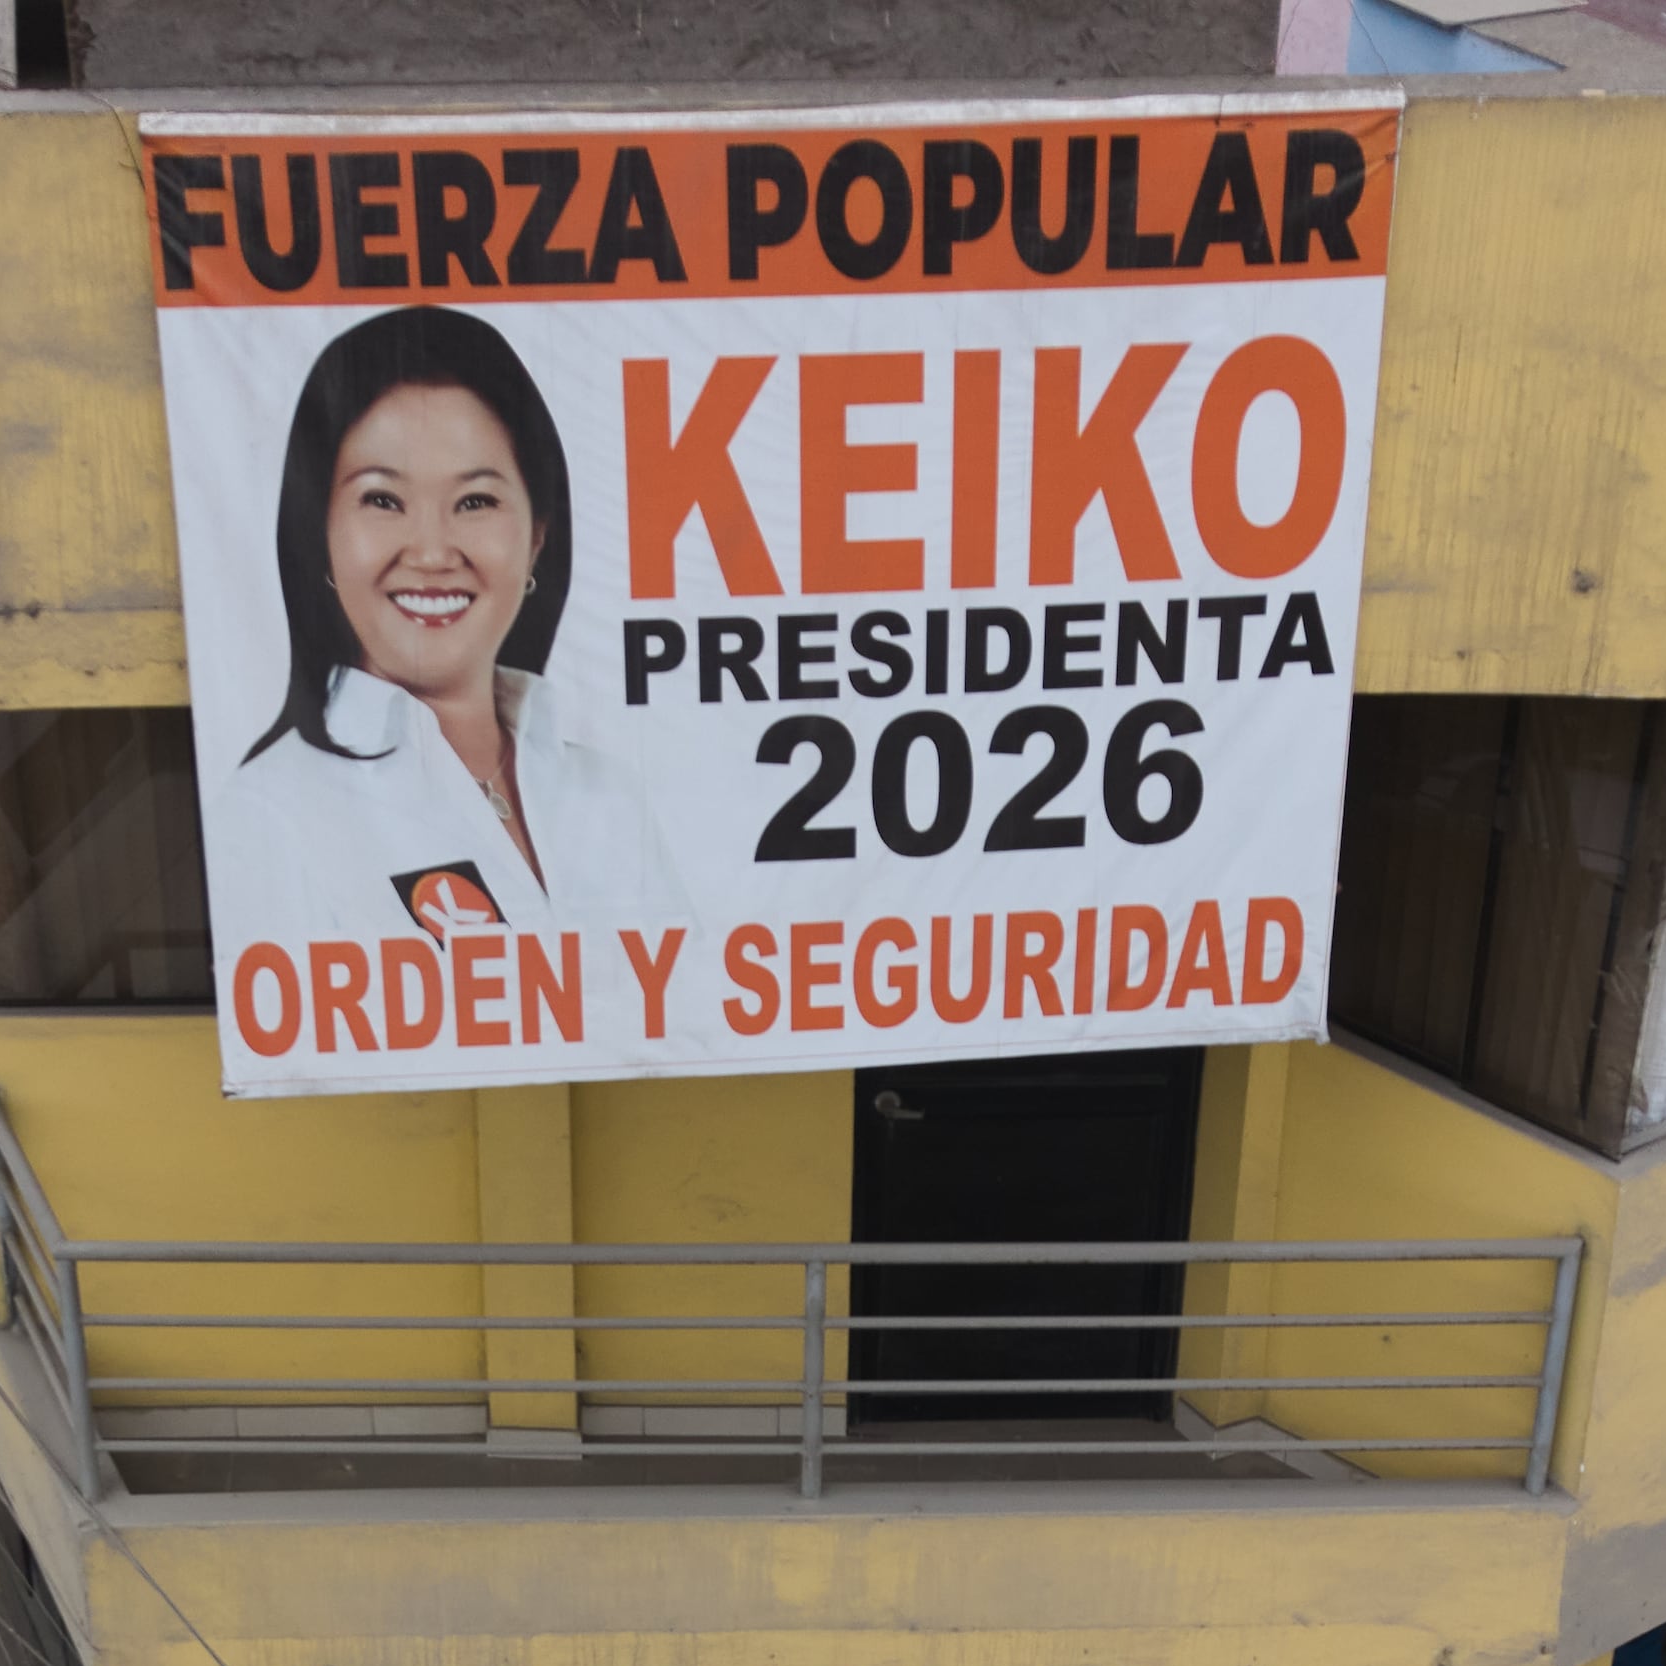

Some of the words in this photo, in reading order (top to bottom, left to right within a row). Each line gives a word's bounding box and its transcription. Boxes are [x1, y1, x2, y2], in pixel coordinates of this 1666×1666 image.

[151, 147, 687, 290] FUERZA
[726, 129, 1365, 283] POPULAR
[622, 335, 1347, 600] KEIKO
[622, 592, 1335, 707] PRESIDENTA
[753, 698, 1206, 864] 2026
[232, 925, 583, 1057] ORDEN
[618, 928, 687, 1040] Y
[722, 896, 1305, 1036] SEGURIDAD
